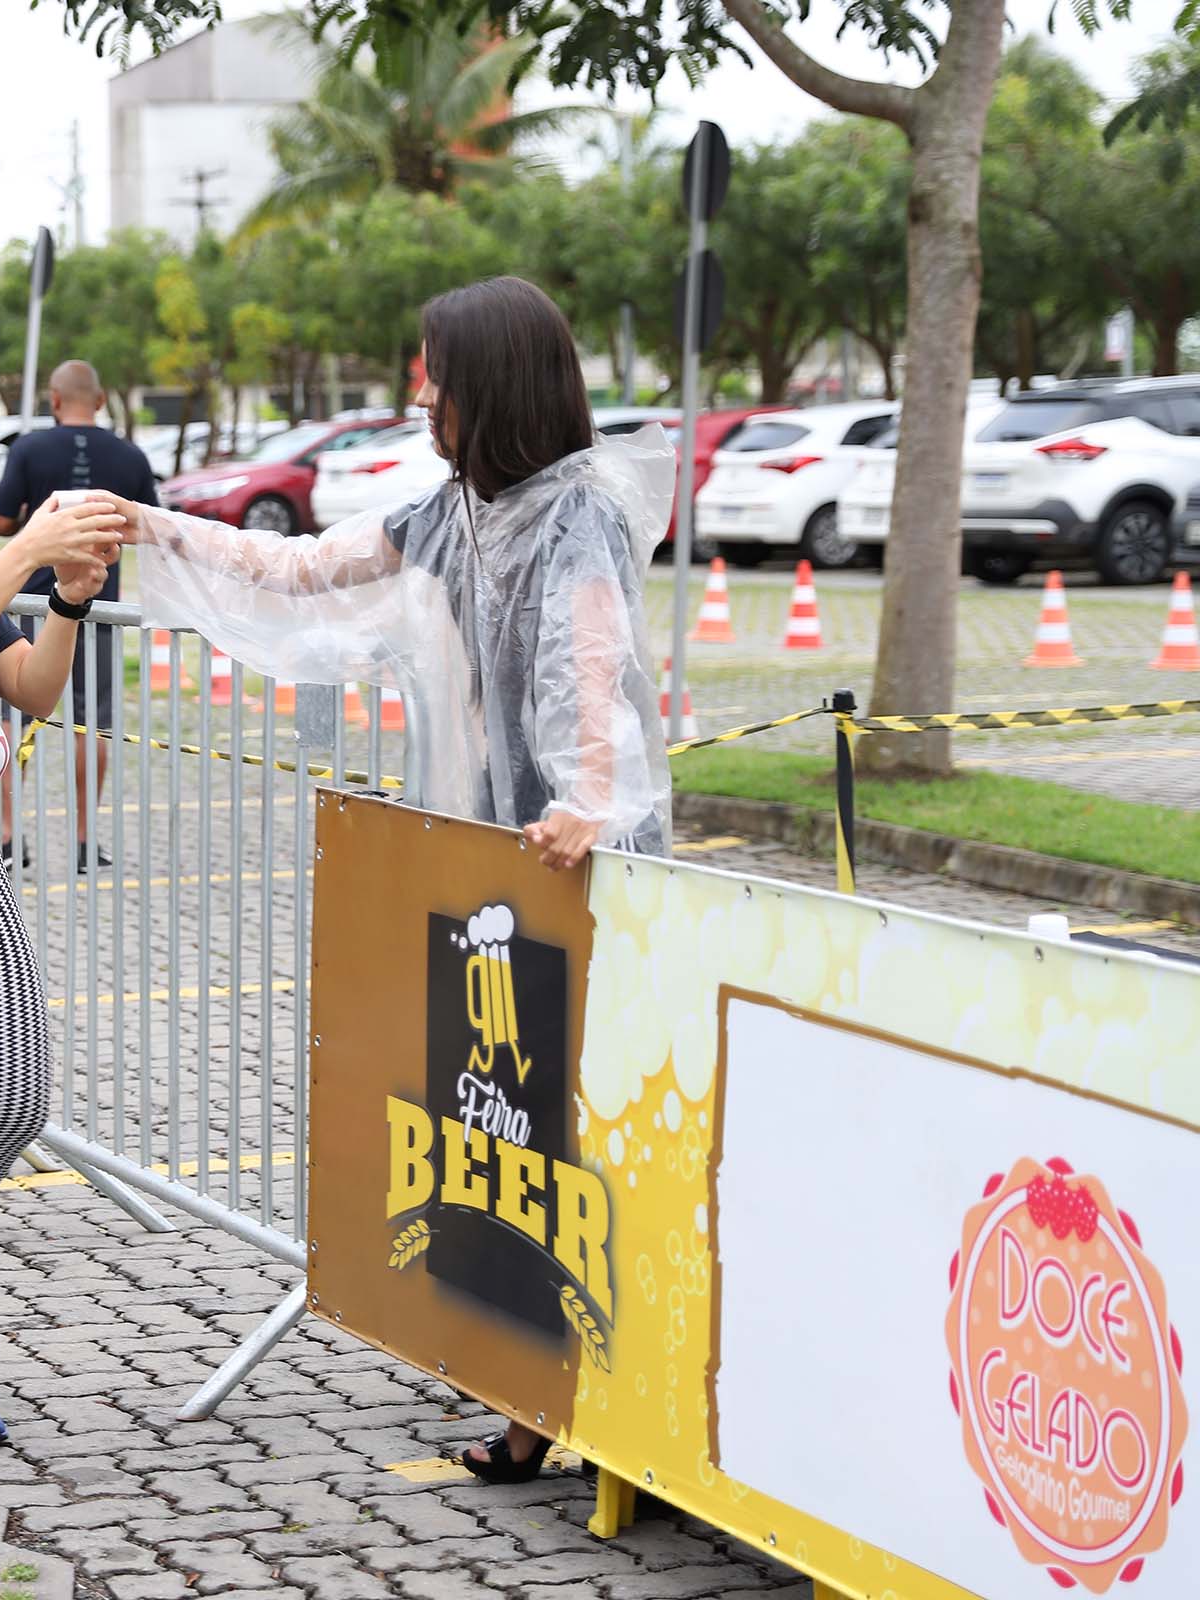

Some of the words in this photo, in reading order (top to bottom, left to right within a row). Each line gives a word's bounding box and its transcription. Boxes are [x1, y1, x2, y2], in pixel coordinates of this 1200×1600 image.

[457, 1072, 532, 1147] Feira
[387, 1095, 614, 1329] BEER
[1000, 1226, 1131, 1372] DOCE
[980, 1347, 1150, 1495] GELADO
[996, 1446, 1064, 1517] Geladinho
[1067, 1475, 1131, 1523] Gourmet
